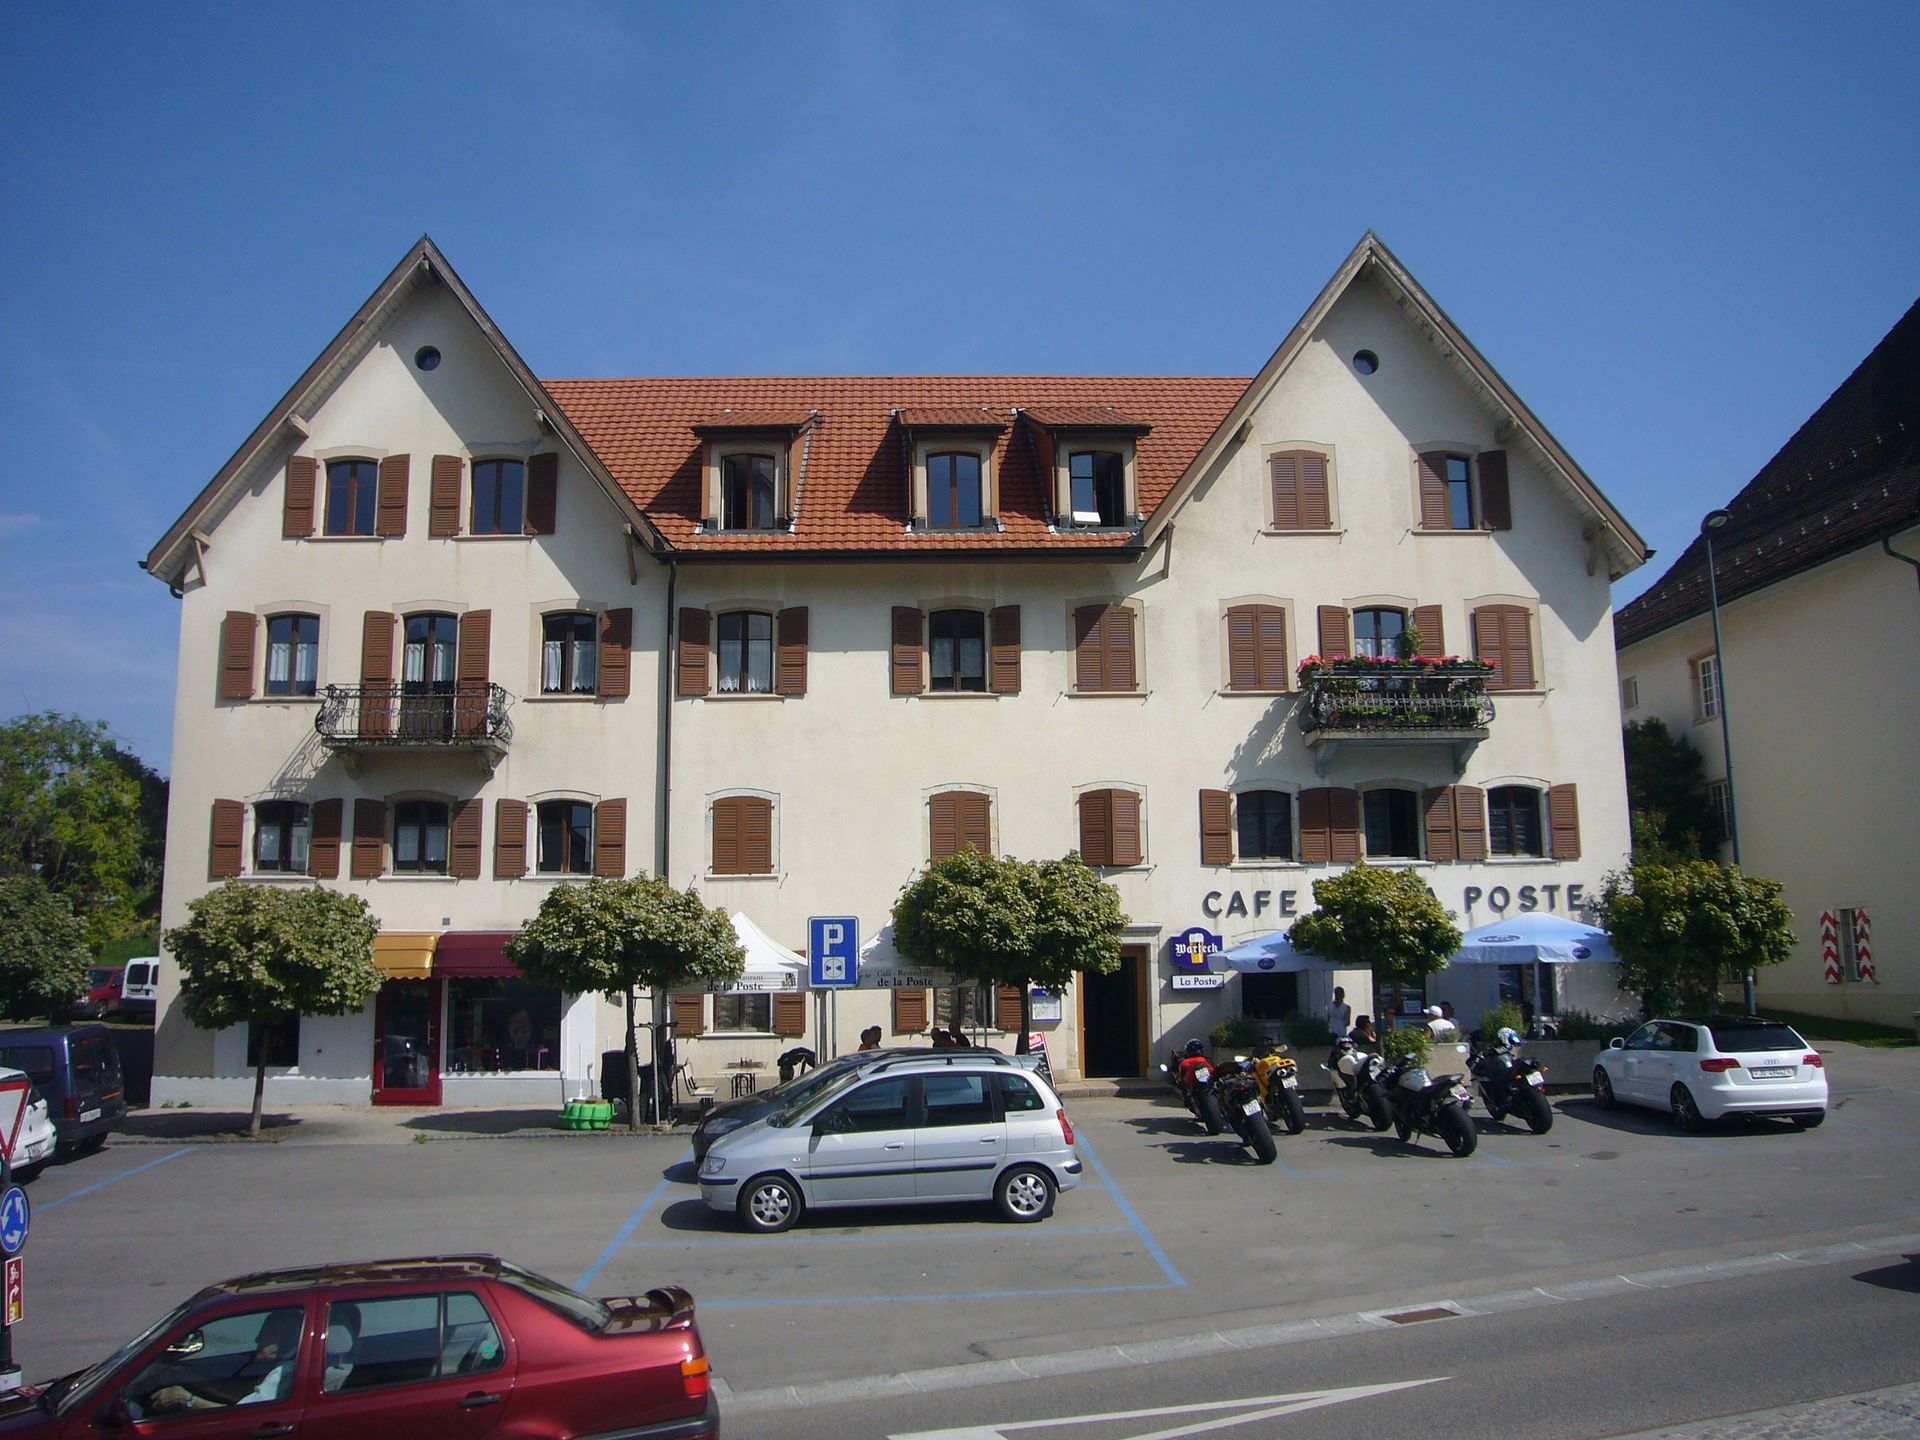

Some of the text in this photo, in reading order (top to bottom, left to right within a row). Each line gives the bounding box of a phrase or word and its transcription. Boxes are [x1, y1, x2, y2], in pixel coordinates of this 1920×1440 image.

[1202, 890, 1297, 918] CAFE
[1464, 885, 1585, 913] POSTE
[823, 924, 844, 955] P
[1175, 943, 1218, 956] Warteck
[707, 980, 763, 991] de la Poste
[878, 977, 934, 987] de la Poste
[1180, 977, 1217, 986] La Poste
